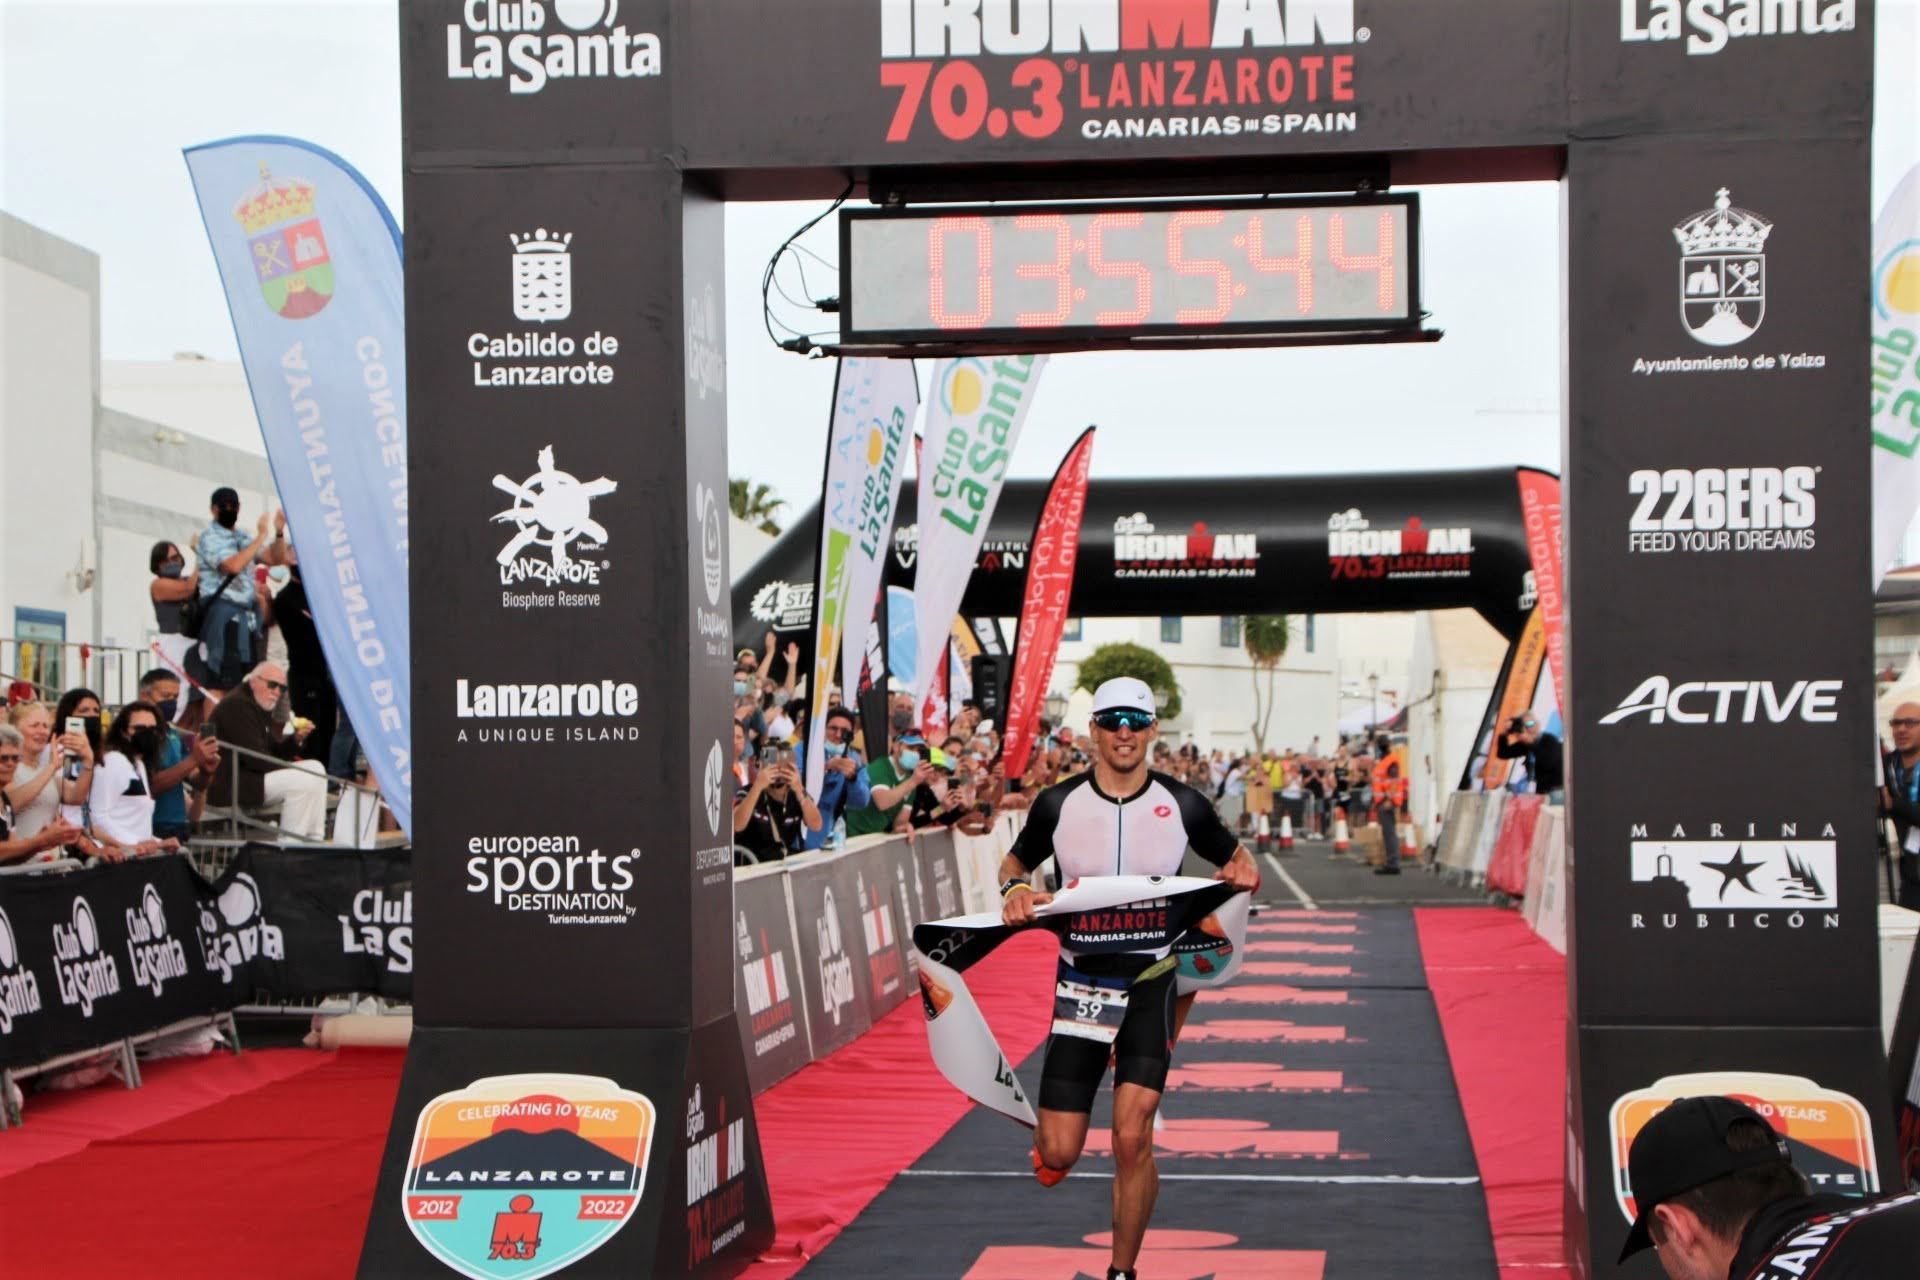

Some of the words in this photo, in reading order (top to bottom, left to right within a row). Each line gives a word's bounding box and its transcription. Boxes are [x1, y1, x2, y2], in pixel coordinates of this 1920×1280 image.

[464, 0, 545, 31] Club
[881, 0, 1355, 57] IRONMAN
[1620, 0, 1856, 55] LaSanta
[447, 24, 661, 93] LaSanta
[1080, 55, 1355, 108] LANZAROTE
[881, 58, 1063, 141] 70.3
[928, 212, 1396, 329] 03:55:44
[467, 332, 575, 358] Cabildo
[583, 331, 619, 356] de
[473, 361, 614, 386] Lanzarote
[1632, 357, 1749, 374] Ayuntamiento
[1752, 355, 1776, 369] de
[1780, 353, 1826, 368] Yaiza
[940, 355, 1034, 535] LaSant
[860, 405, 905, 562] LaSanta
[1629, 466, 1816, 531] 226ERS
[1114, 534, 1257, 561] IRONMAN
[1329, 528, 1472, 556] IRONMAN
[1629, 531, 1676, 552] FEED
[1679, 531, 1731, 551] YOUR
[1735, 529, 1816, 550] DREAMS
[500, 555, 600, 587] LANZAROTE
[1329, 556, 1385, 579] 70.3
[502, 591, 555, 611] Biosphere
[558, 590, 600, 606] Reserve
[457, 679, 639, 717] Lanzarote
[1598, 675, 1844, 724] ACTIVE
[457, 729, 468, 742] A
[479, 728, 554, 742] UNIQUE
[566, 727, 639, 741] ISLAND
[1631, 823, 1837, 838] MARINA
[469, 834, 579, 857] european
[466, 848, 635, 905] sports
[508, 893, 624, 911] DESTINATION
[625, 904, 637, 916] by
[126, 905, 151, 943] Club
[548, 913, 628, 925] TurismoLanzarote
[1070, 911, 1167, 931] LANZAROTE
[1631, 911, 1840, 928] RUBICÓN
[53, 922, 81, 961] Club
[1070, 932, 1127, 942] CANARIAS
[1132, 931, 1166, 940] SPAIN
[127, 933, 188, 997] LaSanta
[53, 950, 121, 1018] LaSanta
[0, 963, 42, 1035] Santa
[1076, 1001, 1102, 1018] 59
[457, 1102, 552, 1122] CELEBRATING
[555, 1103, 572, 1116] 10
[575, 1104, 619, 1122] YEARS
[1778, 1106, 1827, 1122] YEARS
[425, 1171, 626, 1182] LANZAROTE
[416, 1199, 454, 1216] 2012
[584, 1199, 626, 1216] 2022
[487, 1241, 536, 1260] 70.3
